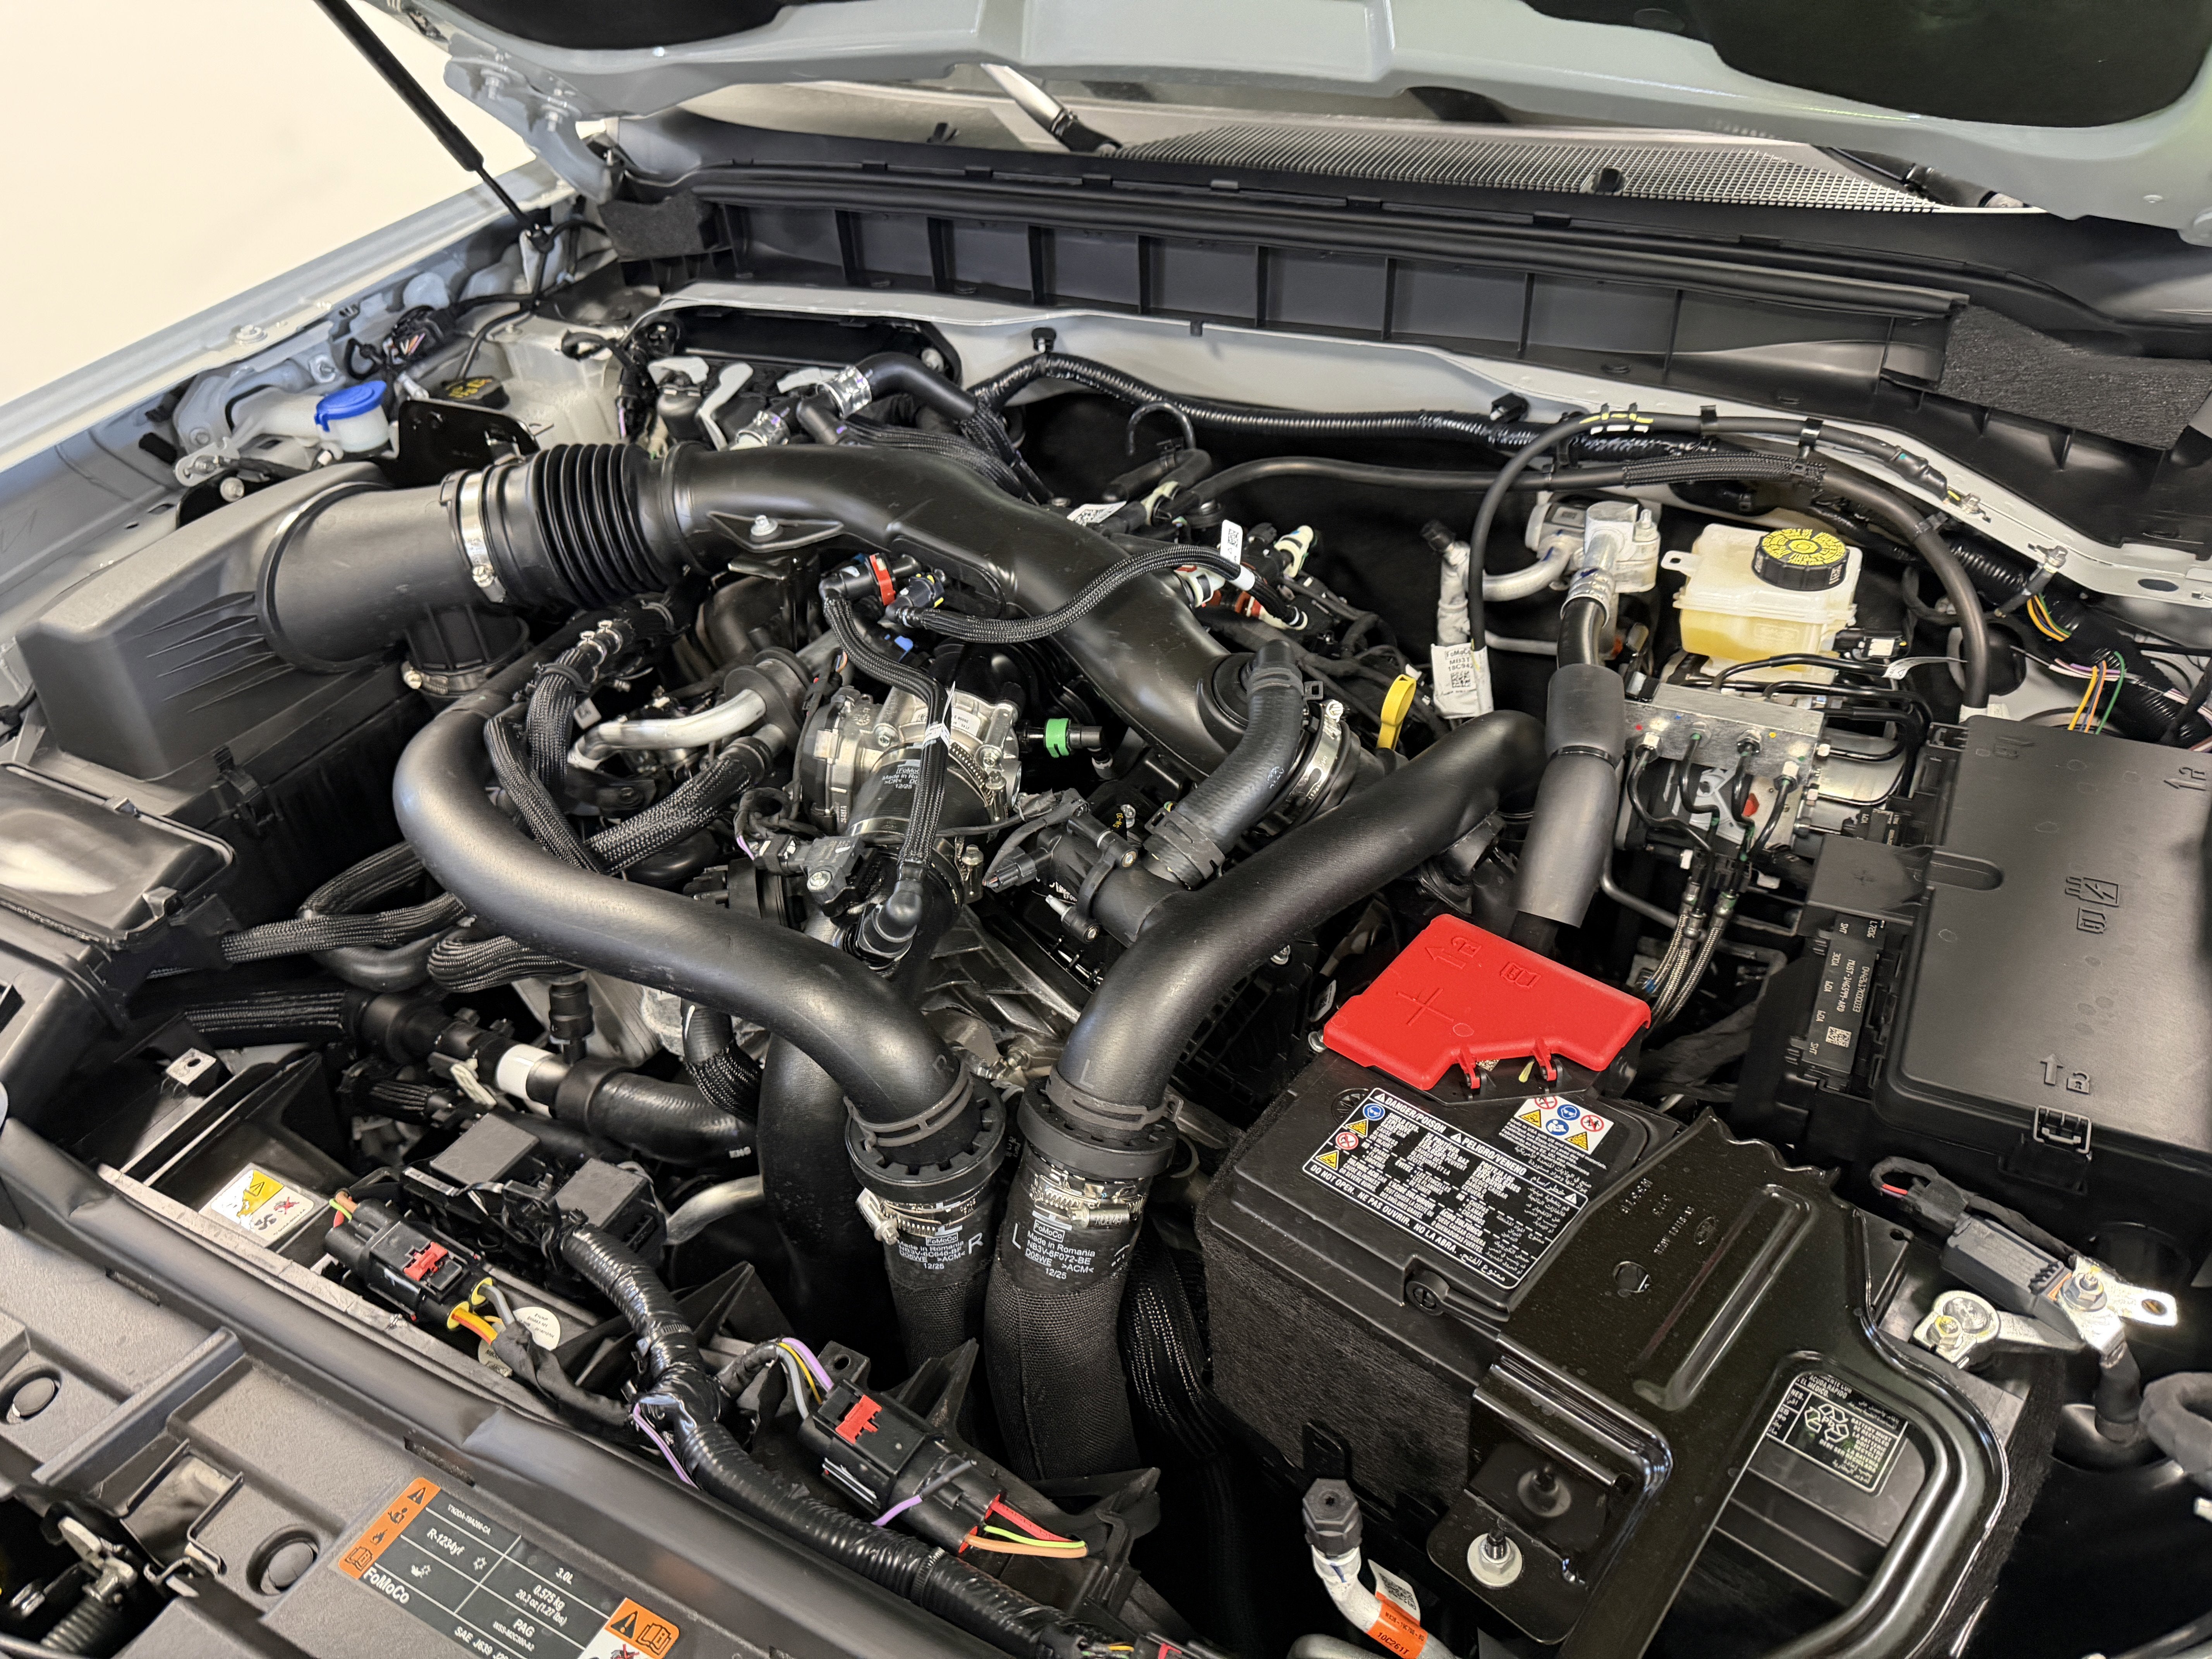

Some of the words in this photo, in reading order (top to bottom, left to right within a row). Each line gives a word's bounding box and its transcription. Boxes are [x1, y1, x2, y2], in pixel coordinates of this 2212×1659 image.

[1383, 1117, 1412, 1134] EXPLOSIVE
[1387, 1112, 1407, 1125] SHIELD
[1372, 1130, 1399, 1146] BLINDNESS
[1376, 1126, 1392, 1137] CAUSE
[1384, 1097, 1447, 1133] DANGER/POISON
[1460, 1137, 1528, 1176] PELIGRO/VENENO
[1409, 1150, 1438, 1168] BLESSURES
[1413, 1146, 1434, 1159] CAUSER
[1431, 1156, 1443, 1165] DES
[1417, 1142, 1447, 1160] EXPLOSIFS
[1421, 1137, 1433, 1146] LES
[1447, 1151, 1459, 1159] LES
[1456, 1156, 1470, 1166] GAZ
[1367, 1169, 1379, 1178] ACID
[1471, 1170, 1506, 1191] EXPLOSIVOS
[1479, 1161, 1505, 1177] PROTEJA
[1503, 1173, 1516, 1183] LOS
[1468, 1175, 1489, 1188] PUEDEN
[1487, 1185, 1509, 1199] CAUSAR
[1491, 1174, 1504, 1183] LOS
[1501, 1179, 1522, 1193] GASES
[1309, 1164, 1323, 1175] DO
[1320, 1170, 1337, 1183] NOT
[1334, 1178, 1358, 1195] OPEN.
[1357, 1192, 1370, 1201] NE
[1367, 1197, 1383, 1209] PAS
[1381, 1206, 1413, 1226] OUVRIR.
[1413, 1223, 1426, 1234] NO
[1424, 1230, 1437, 1240] LA
[1434, 1236, 1460, 1254] ABRA.
[1464, 1204, 1485, 1218] FLAMAS
[1468, 1200, 1490, 1214] CHISPAS
[1460, 1209, 1486, 1226] CIGARROS
[927, 1236, 957, 1244] FoMoCo
[1035, 1223, 1062, 1239] FoMoCo
[969, 1233, 984, 1254] R
[1027, 1230, 1046, 1246] Made
[1057, 1244, 1095, 1257] Romania
[1820, 1415, 1836, 1428] Pb
[423, 1527, 467, 1558] R-1234yf
[531, 1584, 557, 1604] 0.575
[550, 1596, 568, 1612] kg
[553, 1567, 578, 1585] 3.0L
[361, 1566, 415, 1605] FoMoCo
[455, 1626, 473, 1643] SAE
[511, 1618, 538, 1638] PAG
